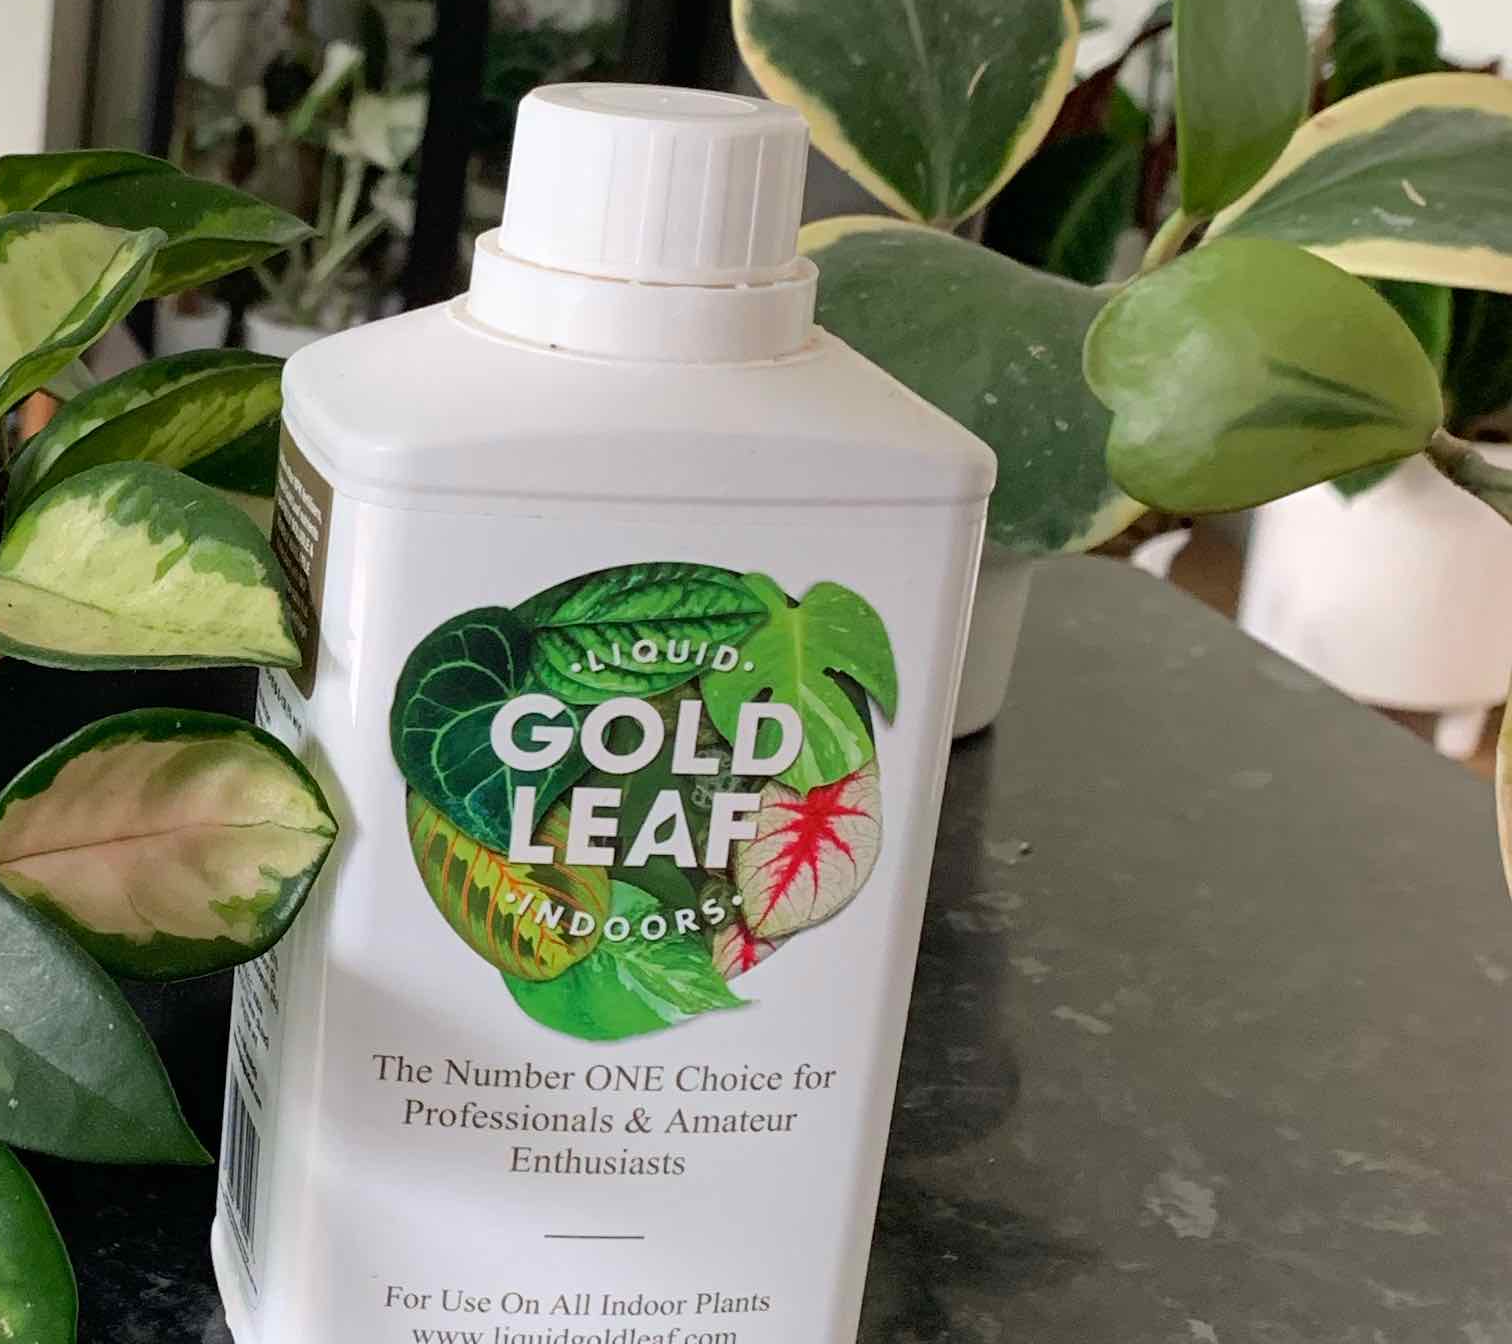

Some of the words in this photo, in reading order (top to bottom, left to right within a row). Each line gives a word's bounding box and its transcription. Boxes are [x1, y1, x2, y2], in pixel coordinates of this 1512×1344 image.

[490, 692, 804, 776] GOLD
[508, 786, 761, 869] LEAF
[373, 1054, 433, 1085] The
[444, 1058, 575, 1091] Number
[585, 1064, 665, 1092] ONE
[676, 1063, 783, 1092] Choice
[792, 1062, 837, 1090] for
[403, 1098, 614, 1135] Professionals
[624, 1107, 652, 1135] &
[664, 1108, 798, 1135] Amateur
[509, 1146, 687, 1177] Enthusiasts
[384, 1285, 433, 1311] For
[441, 1288, 492, 1314] Use
[500, 1291, 540, 1315] On
[549, 1293, 591, 1317] All
[600, 1293, 688, 1317] Indoor
[694, 1291, 772, 1315] Plants
